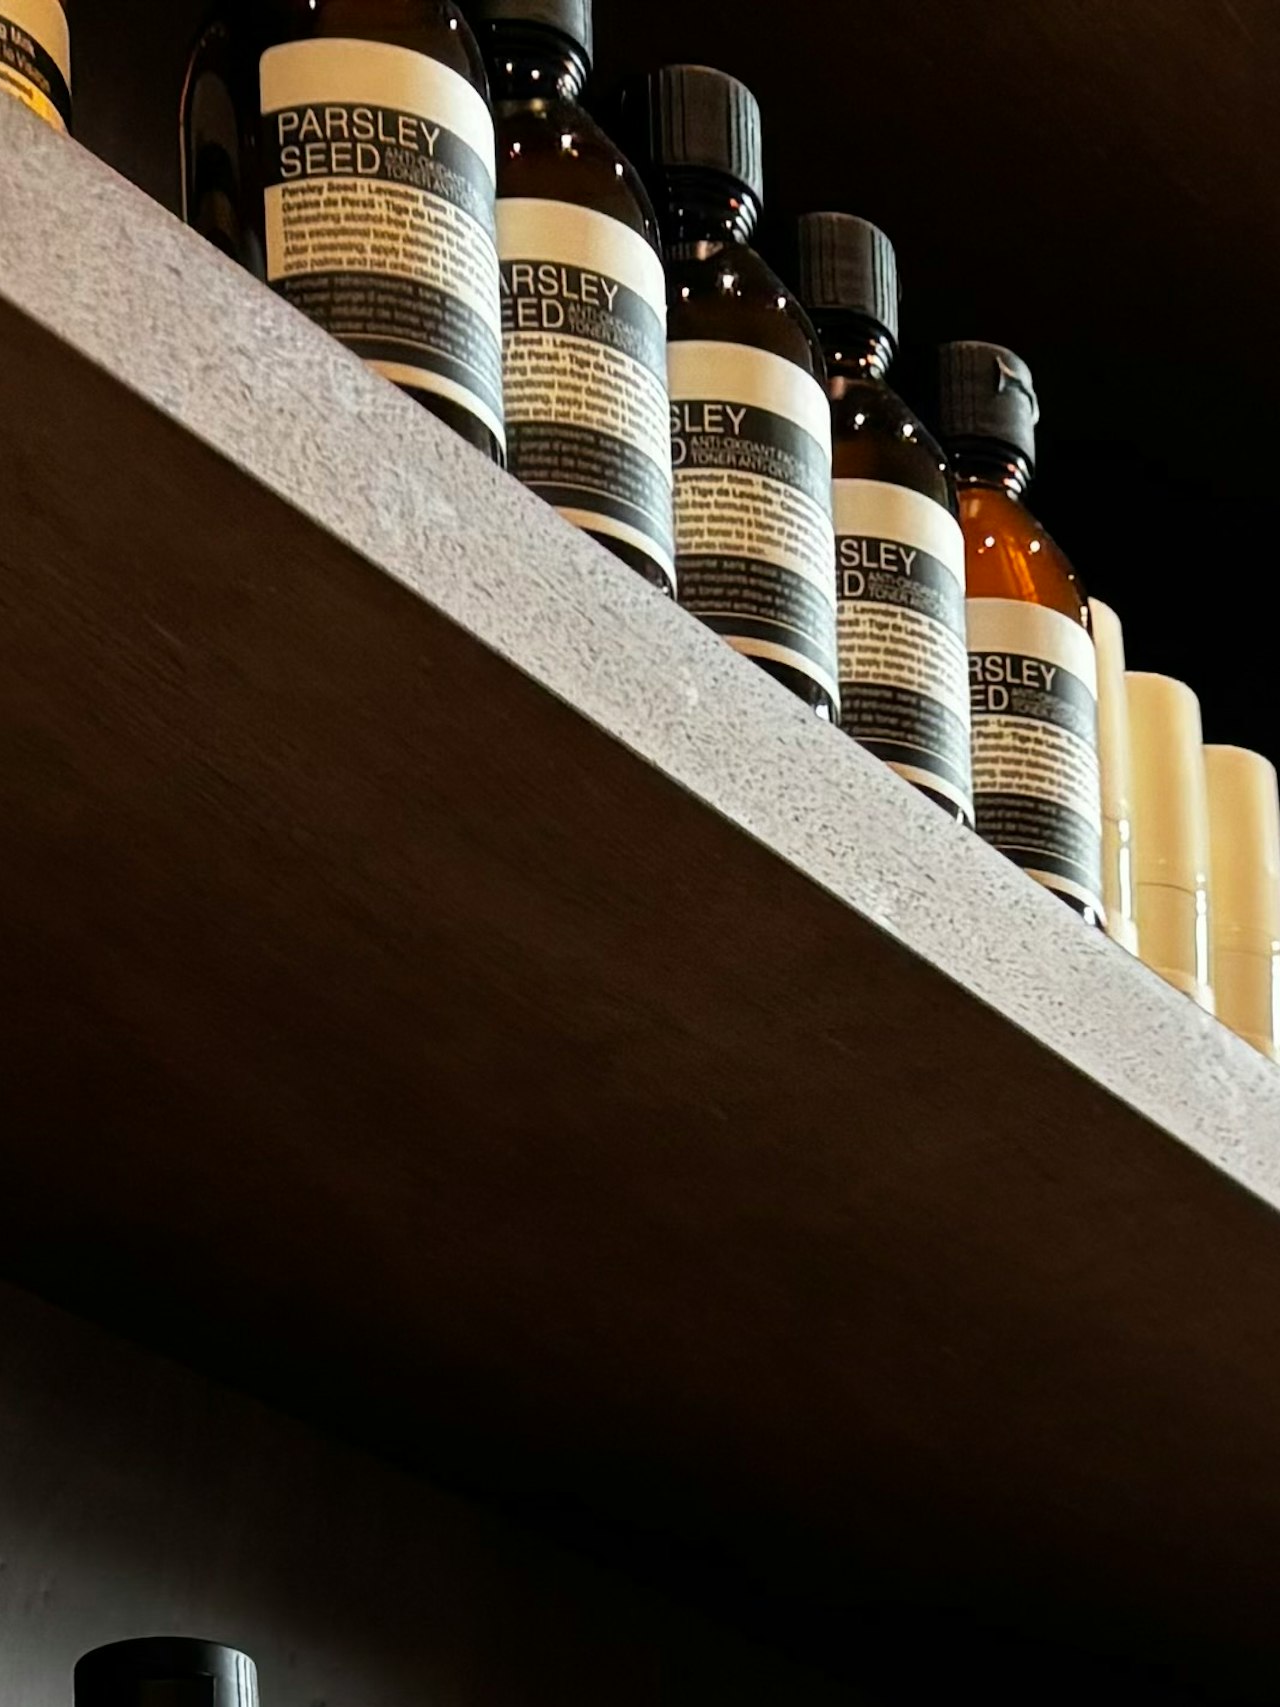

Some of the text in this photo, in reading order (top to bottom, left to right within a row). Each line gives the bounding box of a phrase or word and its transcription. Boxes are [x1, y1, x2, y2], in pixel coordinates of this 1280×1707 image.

[277, 107, 440, 156] PARSLEY
[279, 141, 381, 178] SEED
[499, 264, 618, 312] RSLEY
[501, 298, 565, 329] EED
[840, 539, 918, 576] SLEY
